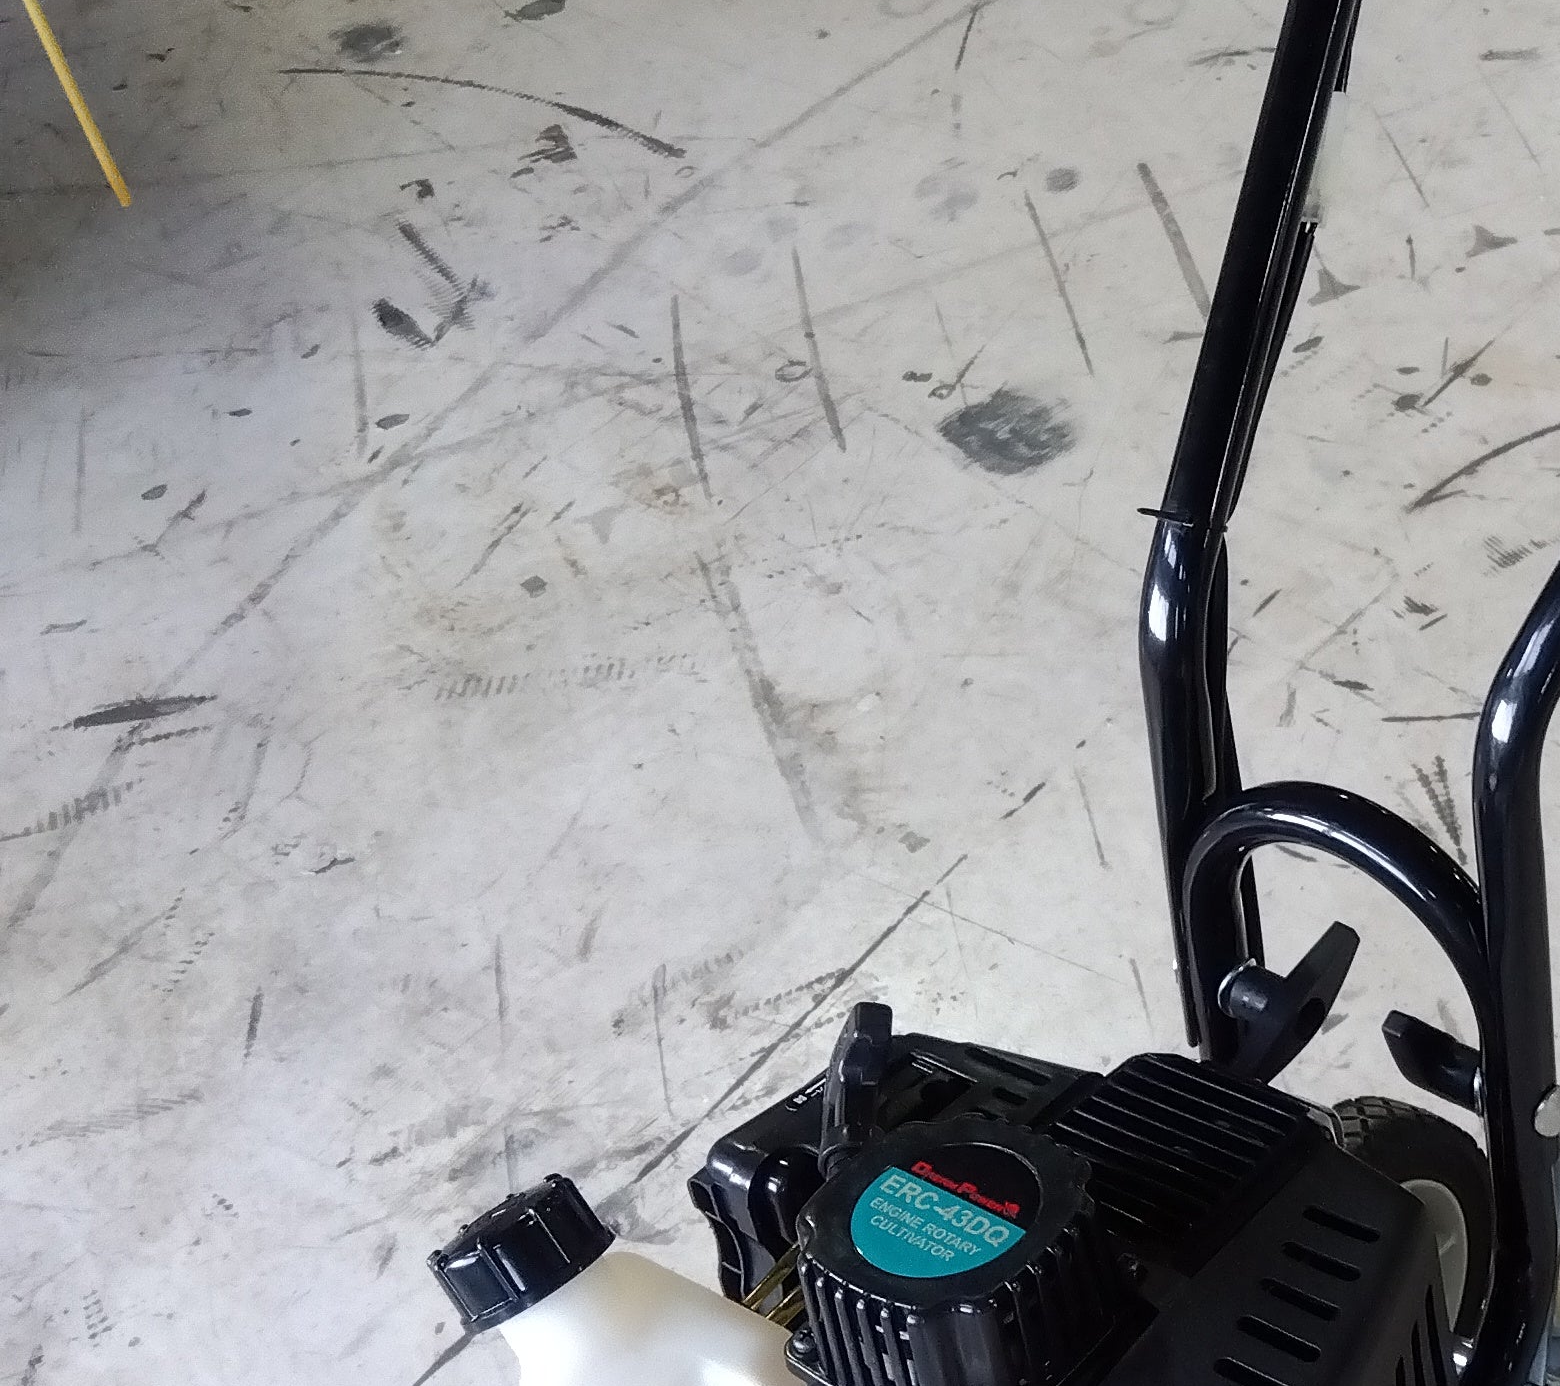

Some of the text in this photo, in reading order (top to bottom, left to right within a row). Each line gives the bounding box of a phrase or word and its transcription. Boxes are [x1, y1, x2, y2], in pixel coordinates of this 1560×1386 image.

[870, 1196, 982, 1256] ENGINE ROTARY
[870, 1215, 955, 1262] CULTIVATOR
[880, 1174, 1010, 1248] ERC-43DQ
